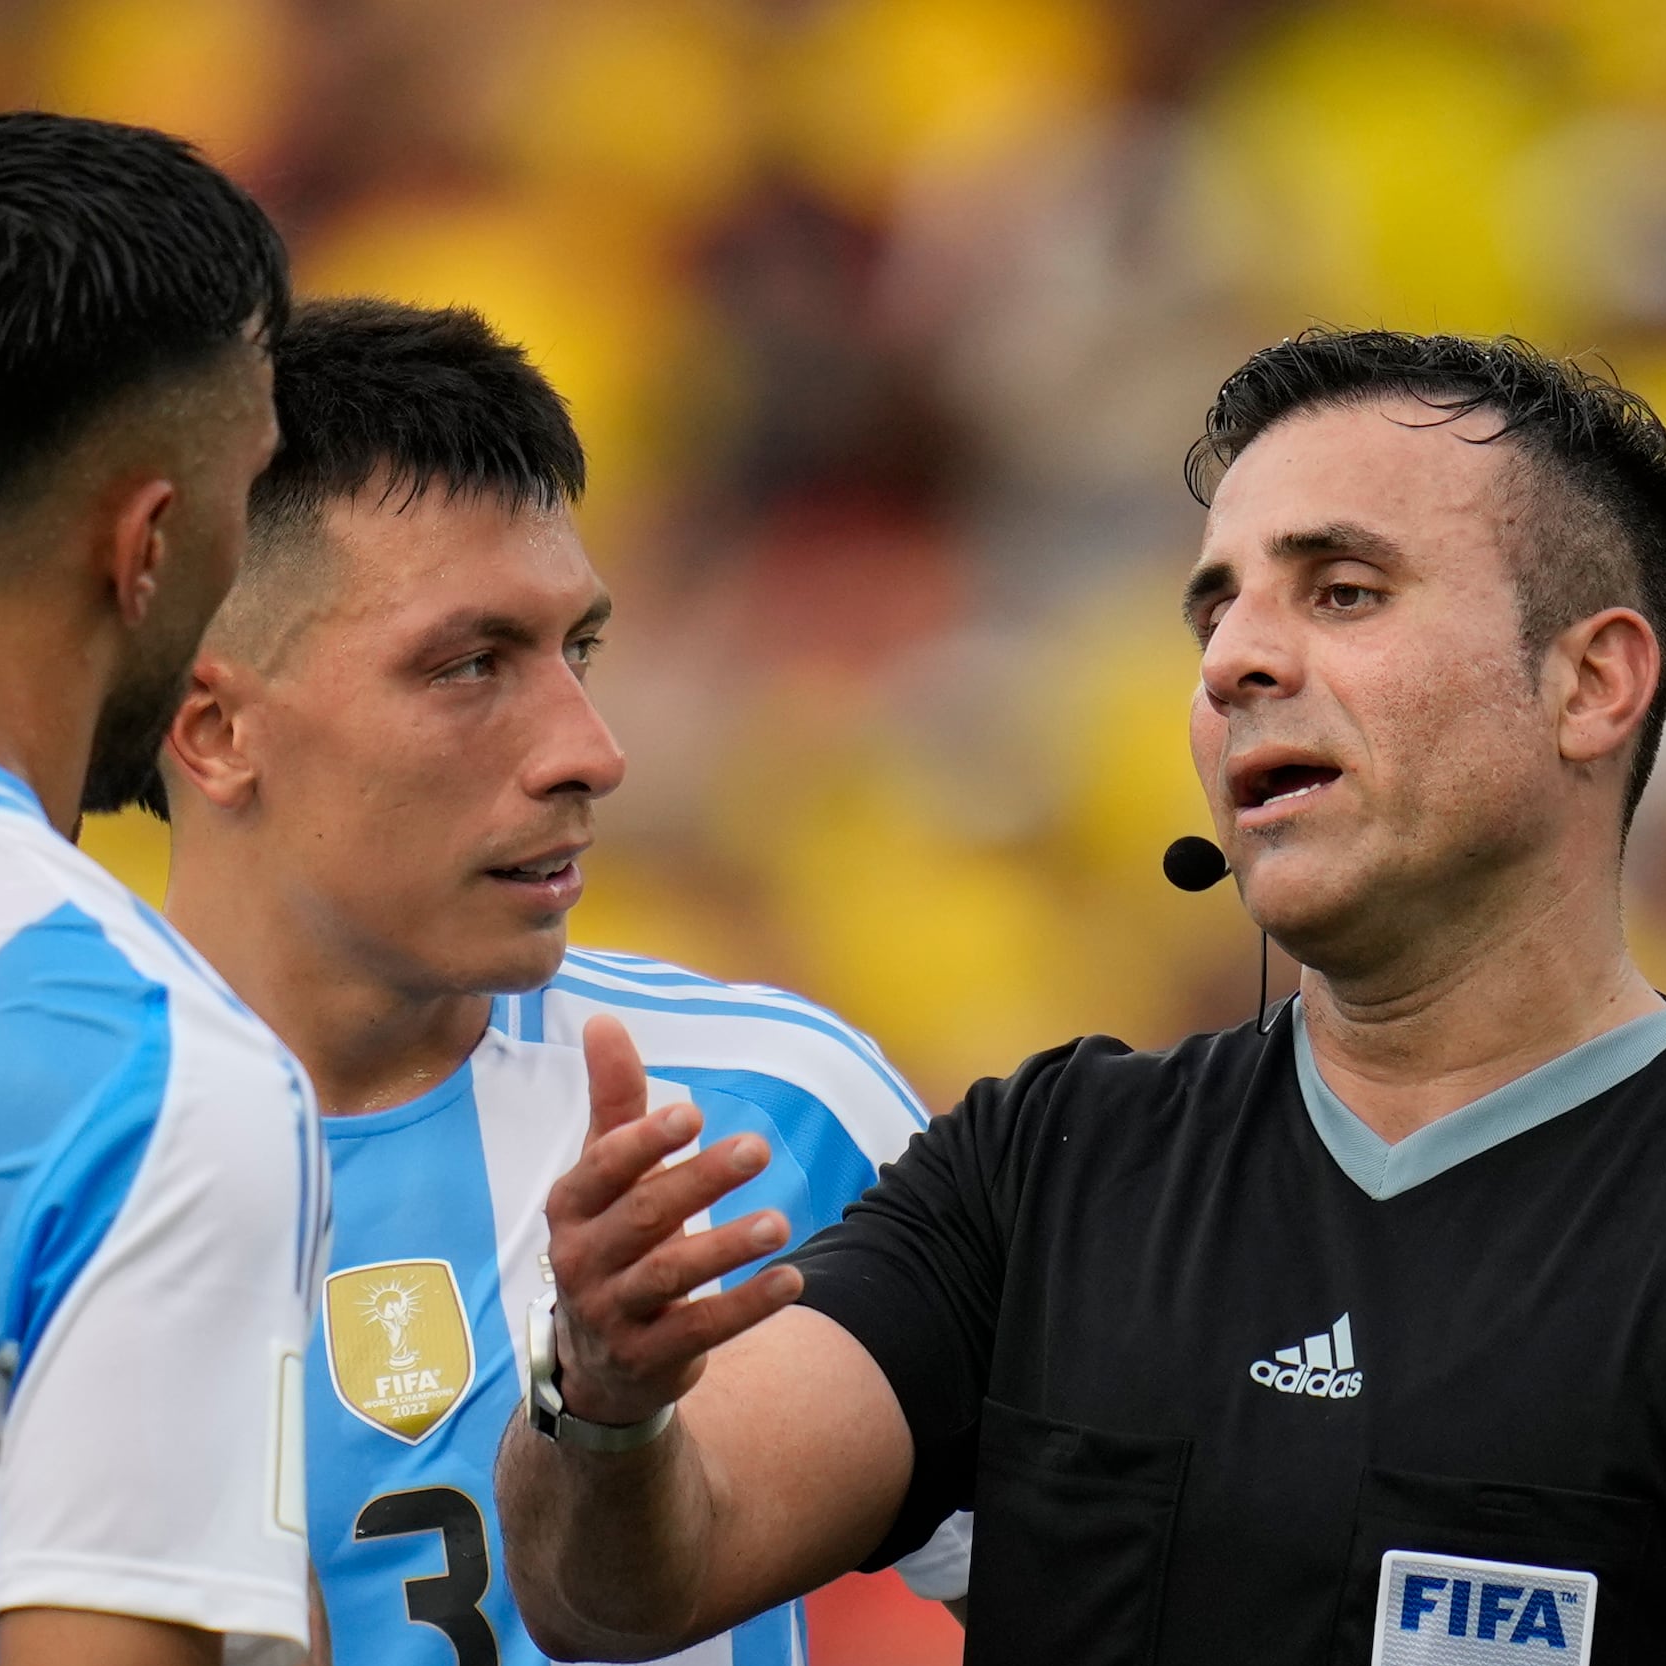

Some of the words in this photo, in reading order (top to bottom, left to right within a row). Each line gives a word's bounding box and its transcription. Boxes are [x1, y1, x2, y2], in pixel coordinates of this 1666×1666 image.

[375, 1369, 440, 1398] FIFA
[1249, 1360, 1364, 1399] adidas
[363, 1398, 396, 1409] WORLD
[391, 1402, 430, 1418] 2022
[1400, 1574, 1567, 1649] FIFA
